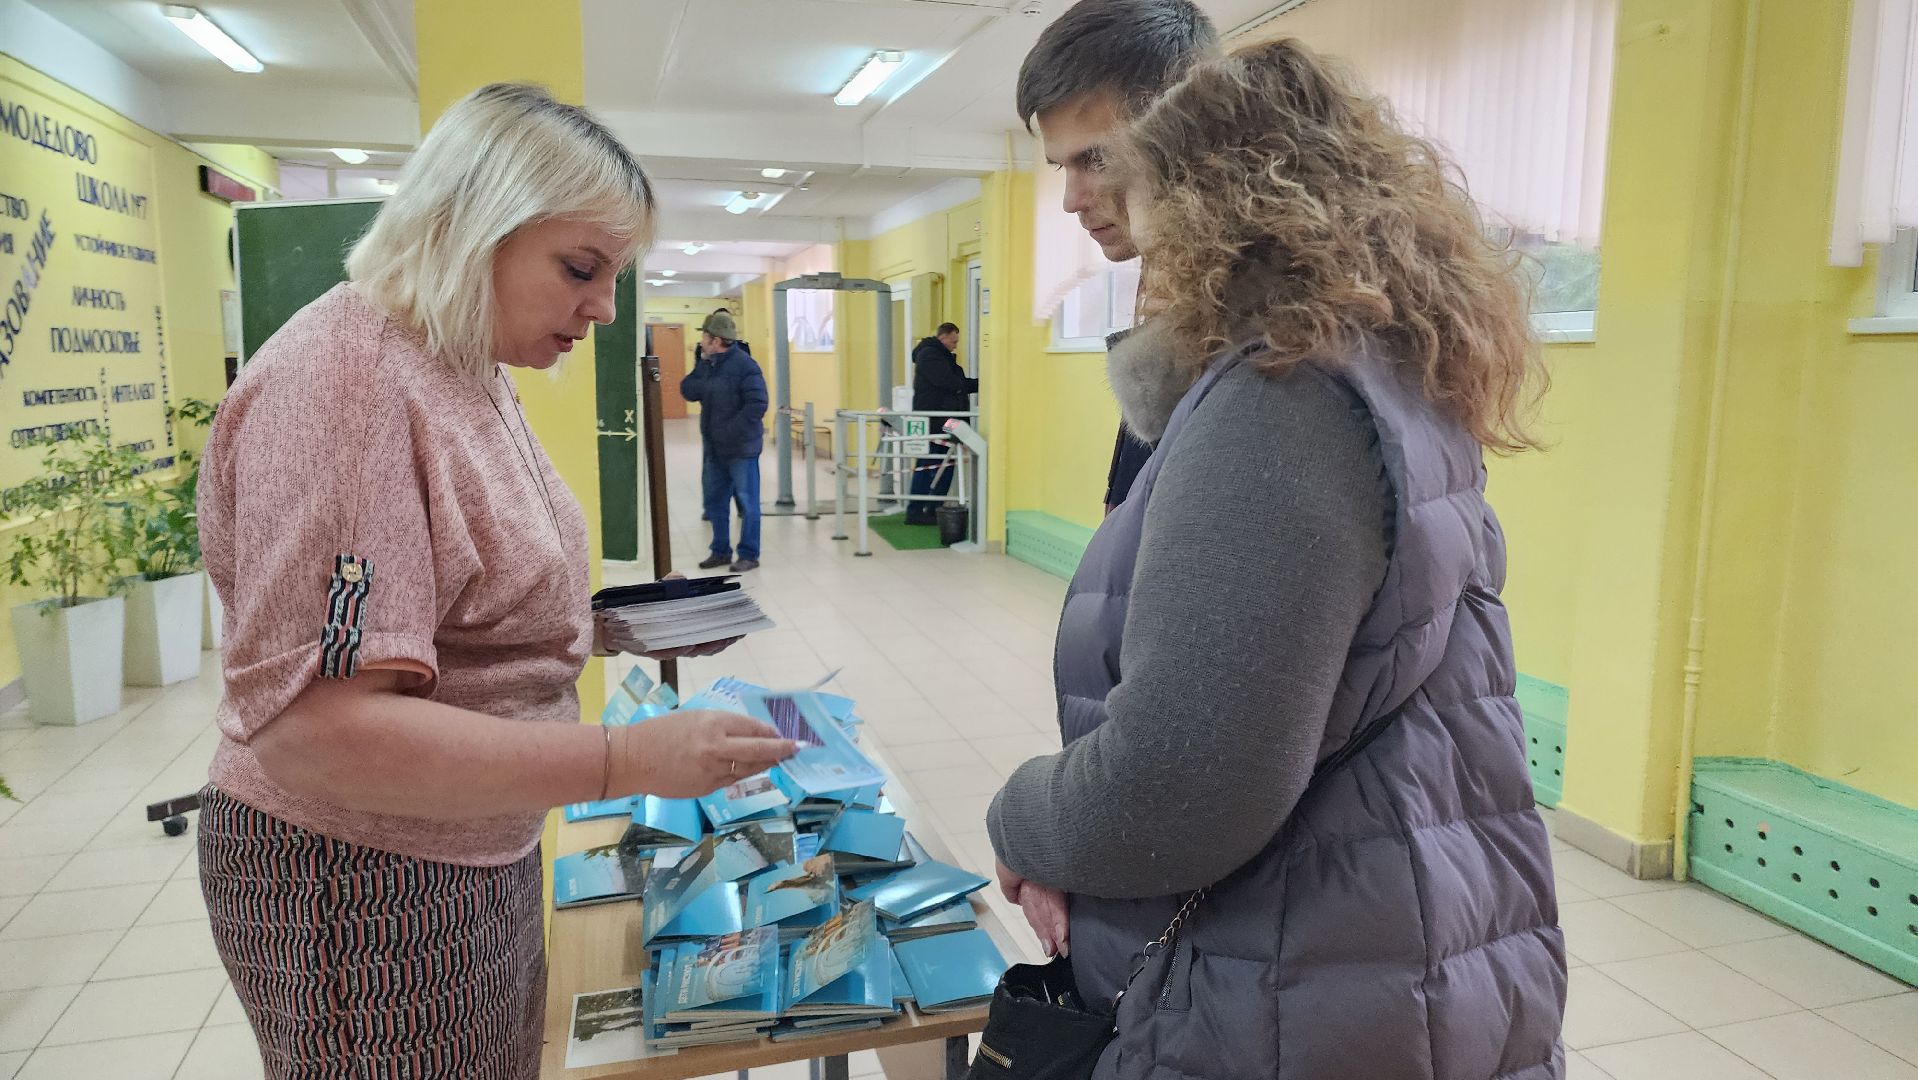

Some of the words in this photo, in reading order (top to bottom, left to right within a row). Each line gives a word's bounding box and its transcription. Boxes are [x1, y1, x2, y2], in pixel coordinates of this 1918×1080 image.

[76, 172, 130, 216] ШКОЛА
[72, 285, 126, 311] ЛИЧНОСТЬ
[50, 327, 141, 353] ПОДМОСКОВЬЕ
